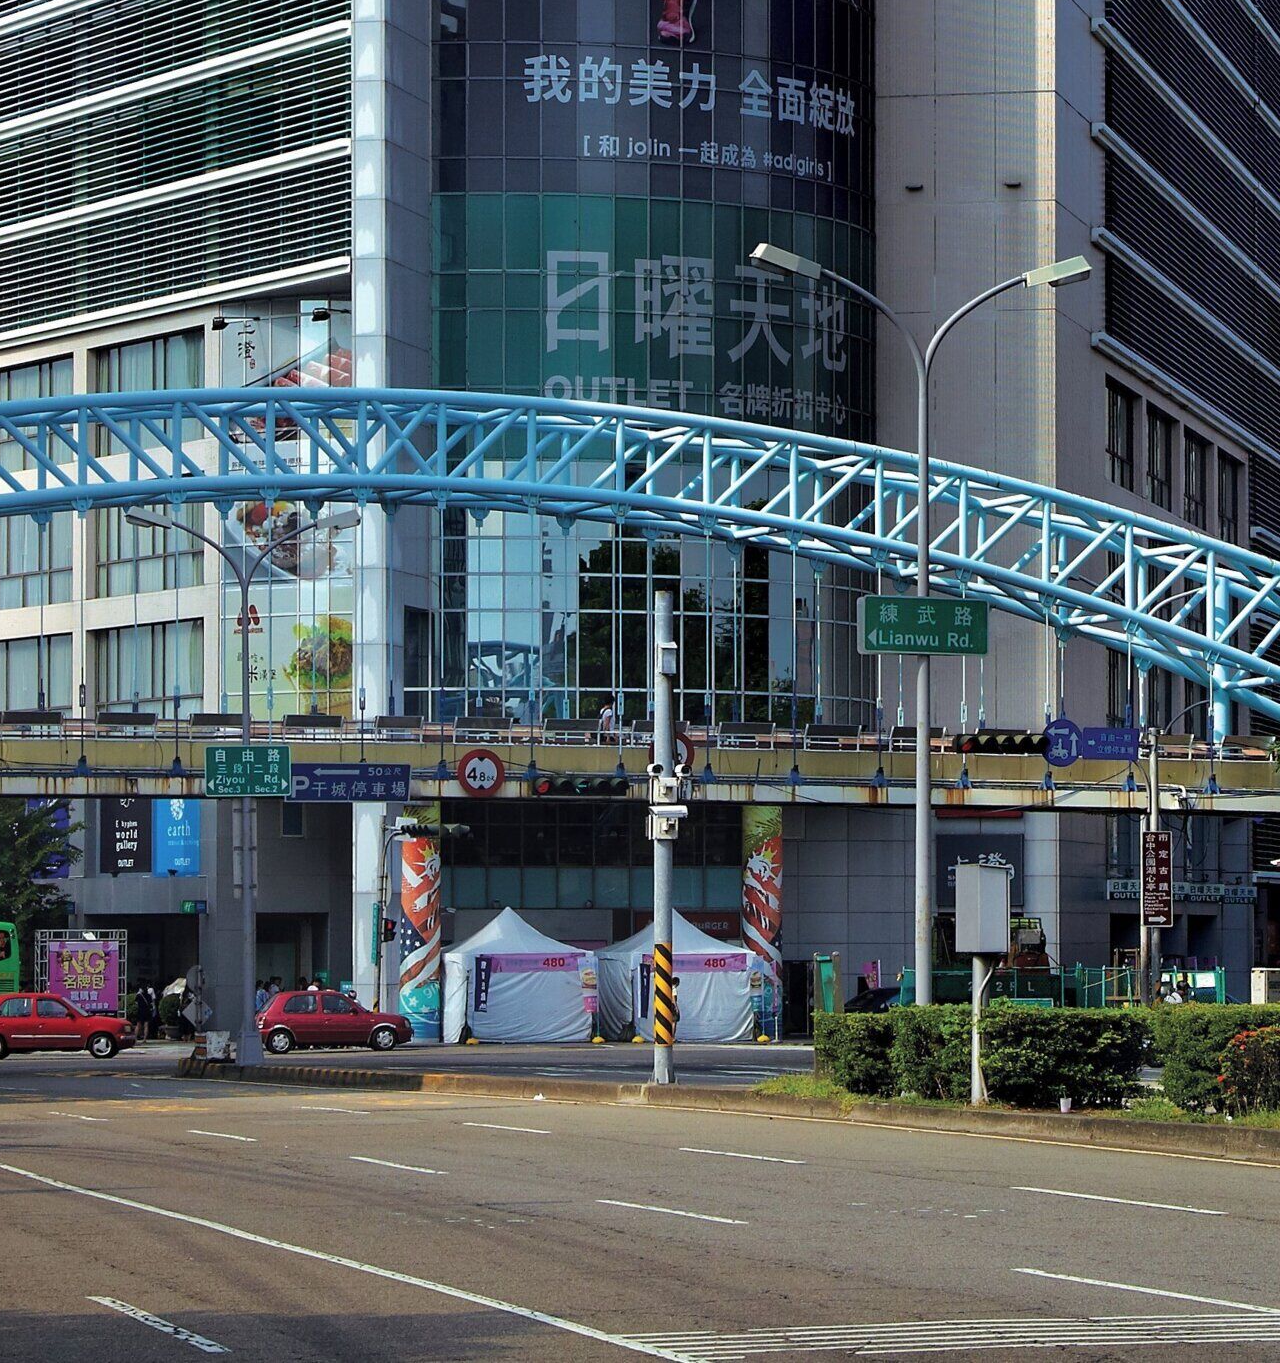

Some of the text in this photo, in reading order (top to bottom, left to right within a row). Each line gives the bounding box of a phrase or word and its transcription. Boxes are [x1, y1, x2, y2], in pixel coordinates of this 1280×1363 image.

[524, 54, 856, 137] 我的美力 全面綻放
[598, 134, 620, 158] 和
[627, 136, 671, 159] jolin
[678, 141, 758, 169] 一起成為
[546, 250, 848, 373] 日曜天地
[543, 374, 695, 412] OUTLET
[719, 381, 847, 426] 名牌折扣中心
[879, 603, 973, 626] 練武路
[878, 629, 974, 648] Lianwu Rd.
[215, 748, 281, 763] 自由路
[217, 764, 280, 774] 三段 二段
[215, 774, 281, 785] Ziyou Rd.
[292, 775, 310, 799] P
[218, 784, 277, 793] Sec.3 Sec.2
[115, 829, 138, 839] world
[167, 821, 191, 837] earth
[115, 840, 138, 852] gallery
[1113, 881, 1140, 891] 日曜天
[543, 957, 566, 967] 480
[704, 958, 727, 968] 480
[63, 974, 105, 989] 名牌包
